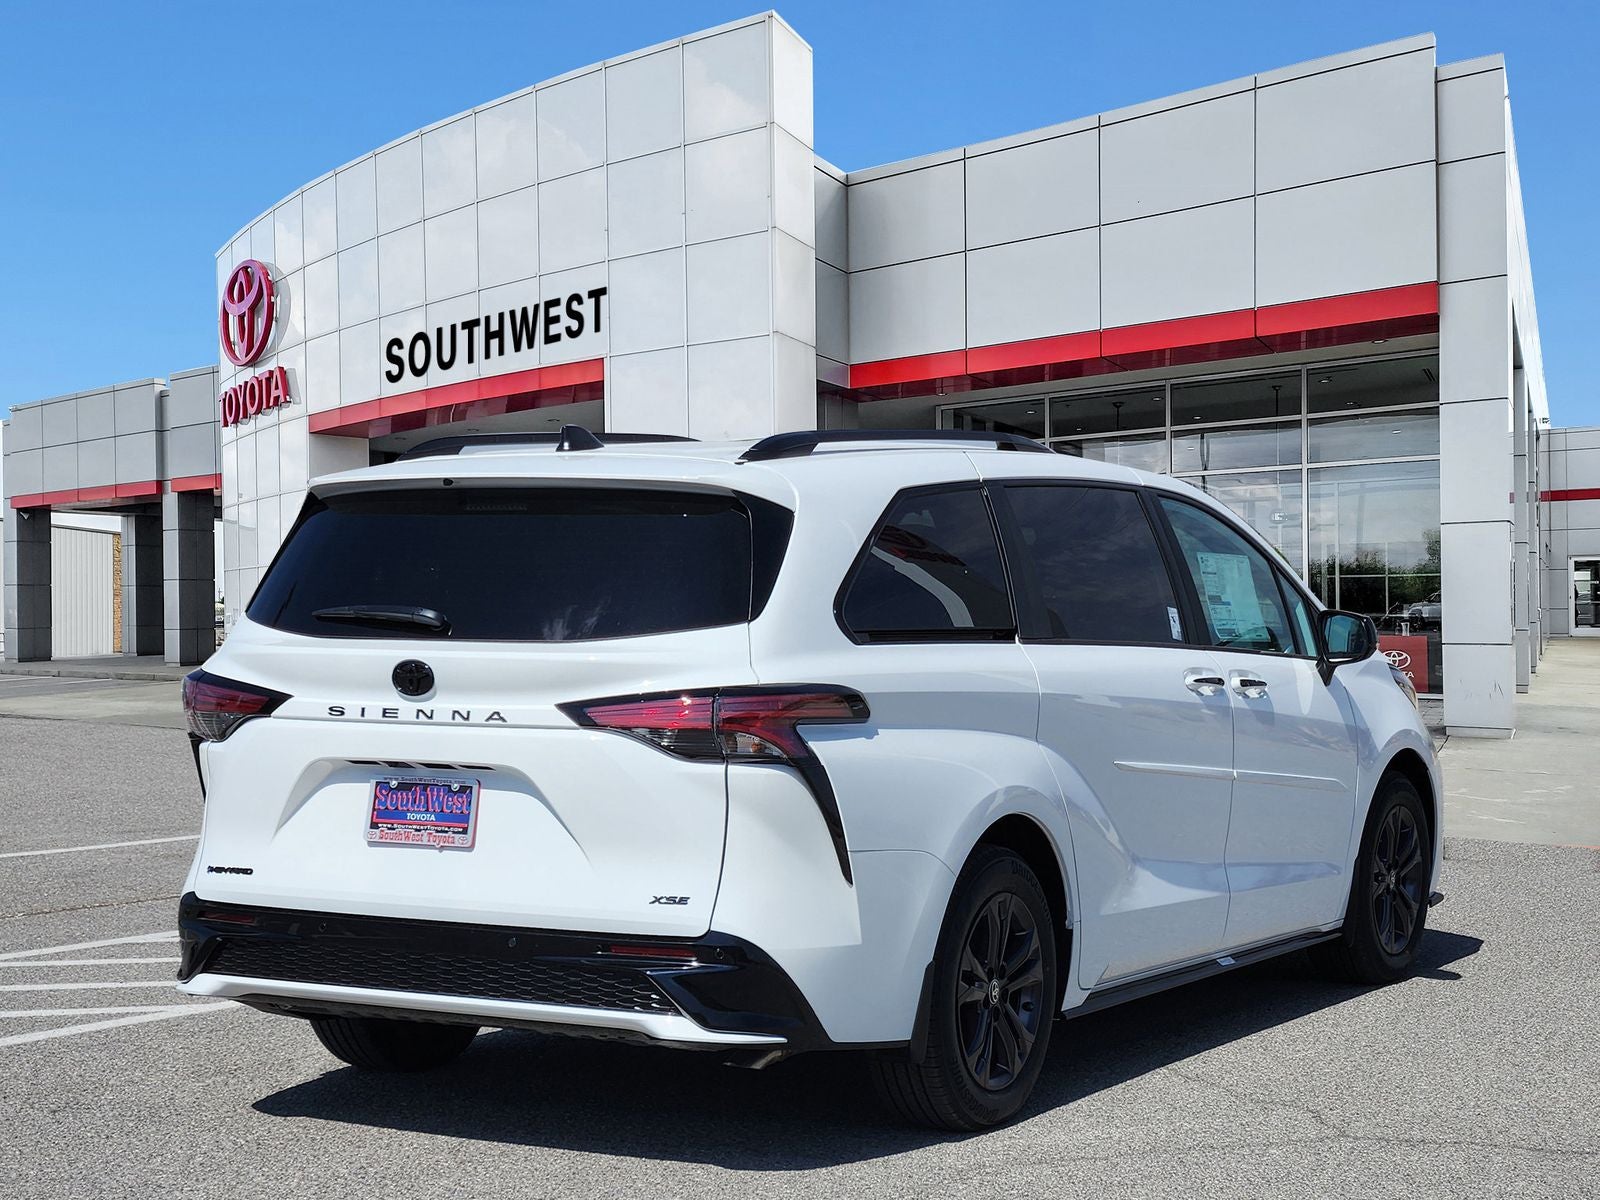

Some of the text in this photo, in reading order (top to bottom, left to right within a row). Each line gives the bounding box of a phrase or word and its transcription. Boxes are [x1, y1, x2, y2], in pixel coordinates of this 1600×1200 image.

[385, 287, 607, 383] SOUTHWEST
[219, 366, 291, 428] TOYOTA
[328, 706, 507, 722] SIENNA
[407, 813, 436, 821] TOYOTA
[427, 832, 455, 845] Toyota
[649, 896, 691, 905] XSE
